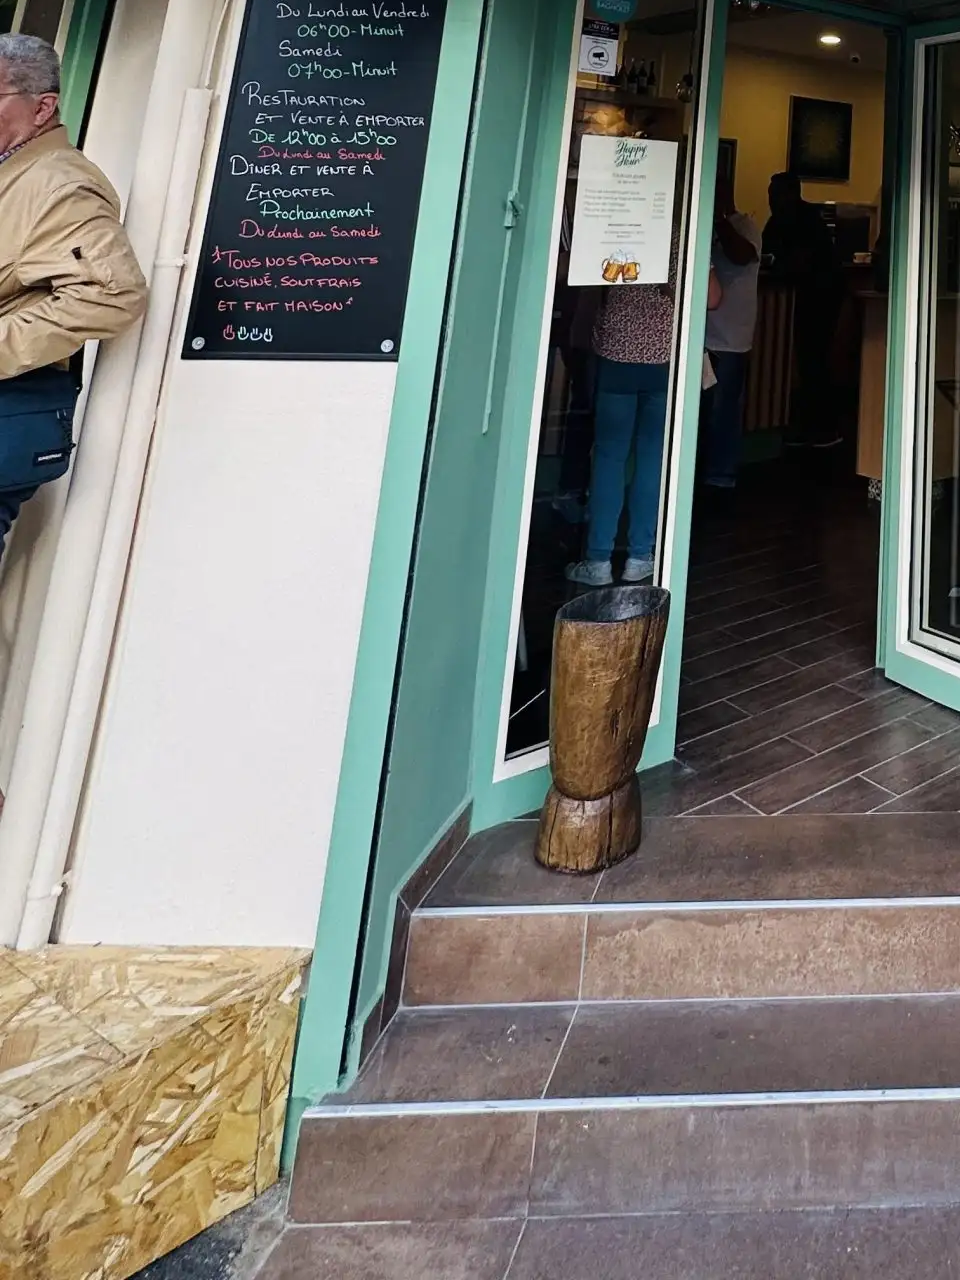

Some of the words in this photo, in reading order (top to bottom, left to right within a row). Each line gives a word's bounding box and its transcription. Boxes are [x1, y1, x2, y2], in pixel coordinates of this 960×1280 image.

[308, 3, 349, 18] Lundi
[352, 9, 368, 17] au
[372, 1, 429, 19] Vendredi
[279, 40, 342, 57] Samedi
[241, 81, 365, 106] RESTAURATION
[255, 113, 283, 125] ET
[291, 112, 335, 126] VENTE
[339, 110, 349, 126] À
[355, 115, 425, 127] EMPORTER
[281, 128, 327, 146] 12h00
[330, 133, 342, 144] à
[347, 128, 397, 146] 15h00
[338, 148, 386, 161] Samedi
[615, 140, 648, 157] Happy
[290, 165, 311, 176] ET
[317, 165, 356, 176] VENTE
[363, 161, 374, 176] À
[246, 183, 335, 201] EMPORTER
[259, 200, 375, 220] Prochainement
[331, 224, 381, 238] Samedi
[266, 256, 297, 266] NOS
[300, 253, 378, 266] PRODUITS
[217, 300, 238, 312] ET
[244, 301, 279, 312] FAIT
